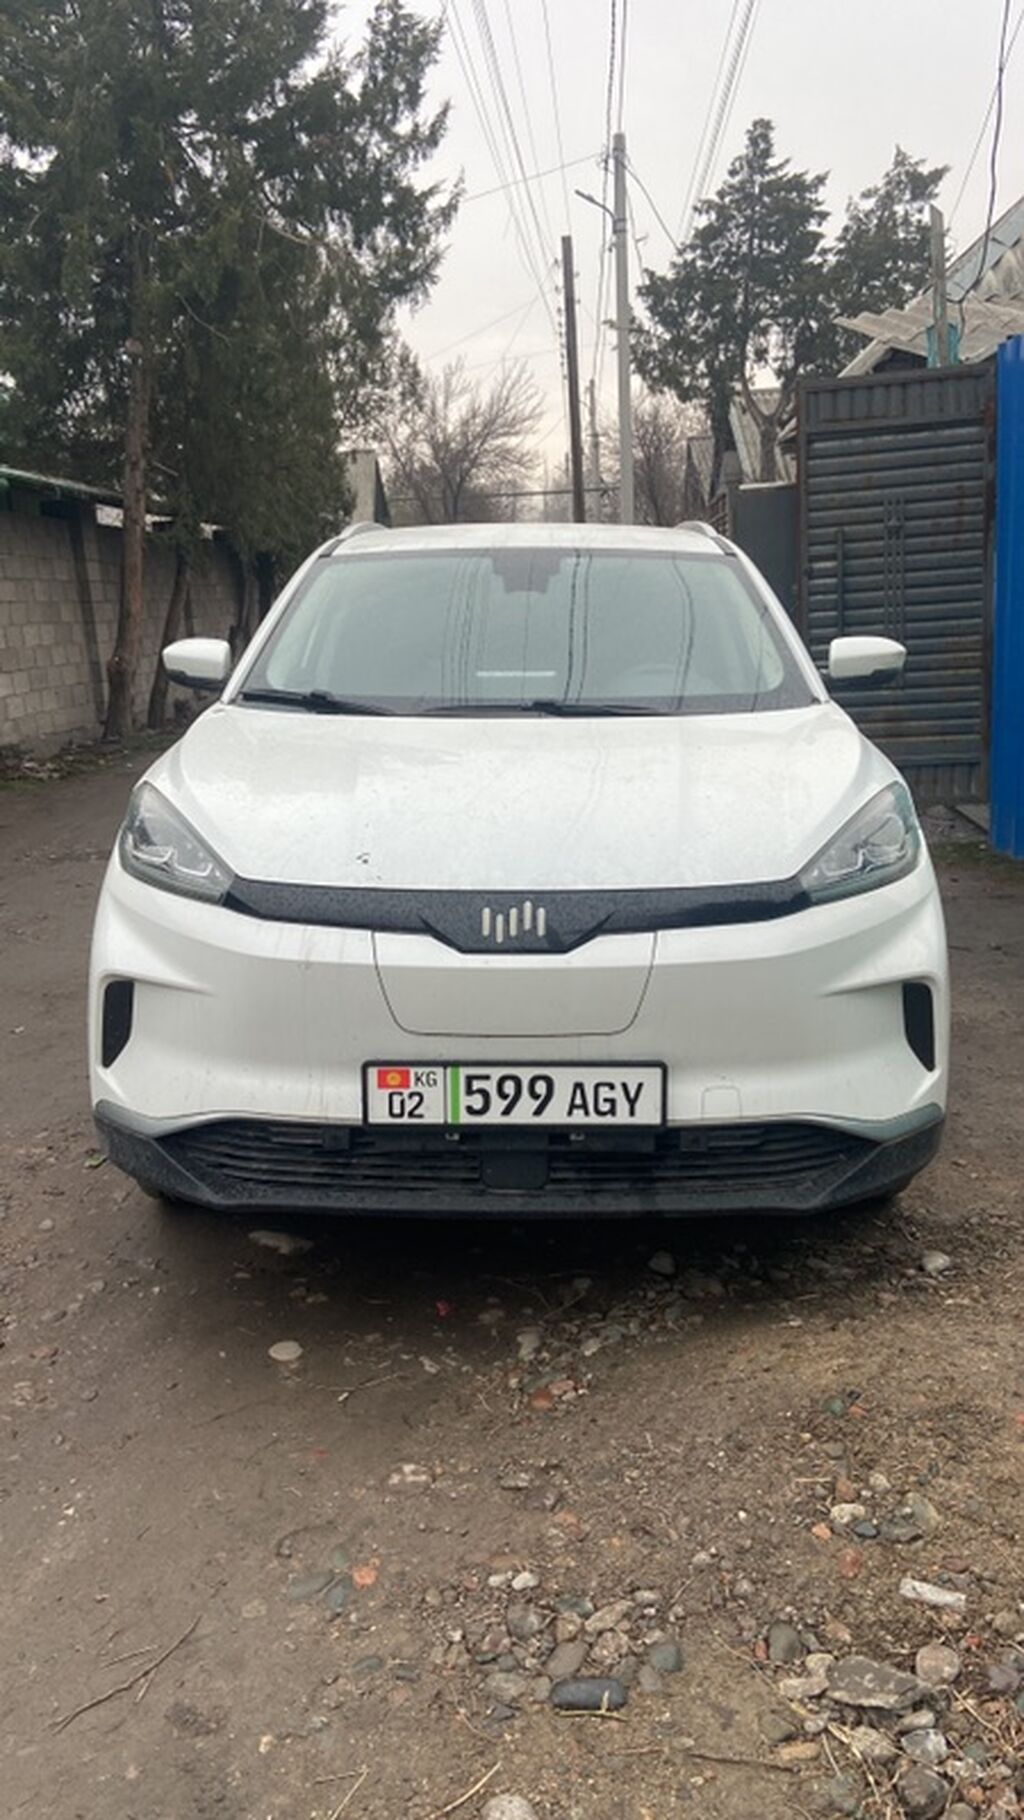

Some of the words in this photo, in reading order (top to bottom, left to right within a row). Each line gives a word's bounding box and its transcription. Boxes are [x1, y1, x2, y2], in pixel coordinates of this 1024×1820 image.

[413, 1071, 437, 1087] KG
[388, 1091, 425, 1119] 02
[464, 1074, 555, 1117] 599
[566, 1081, 644, 1118] AGY
